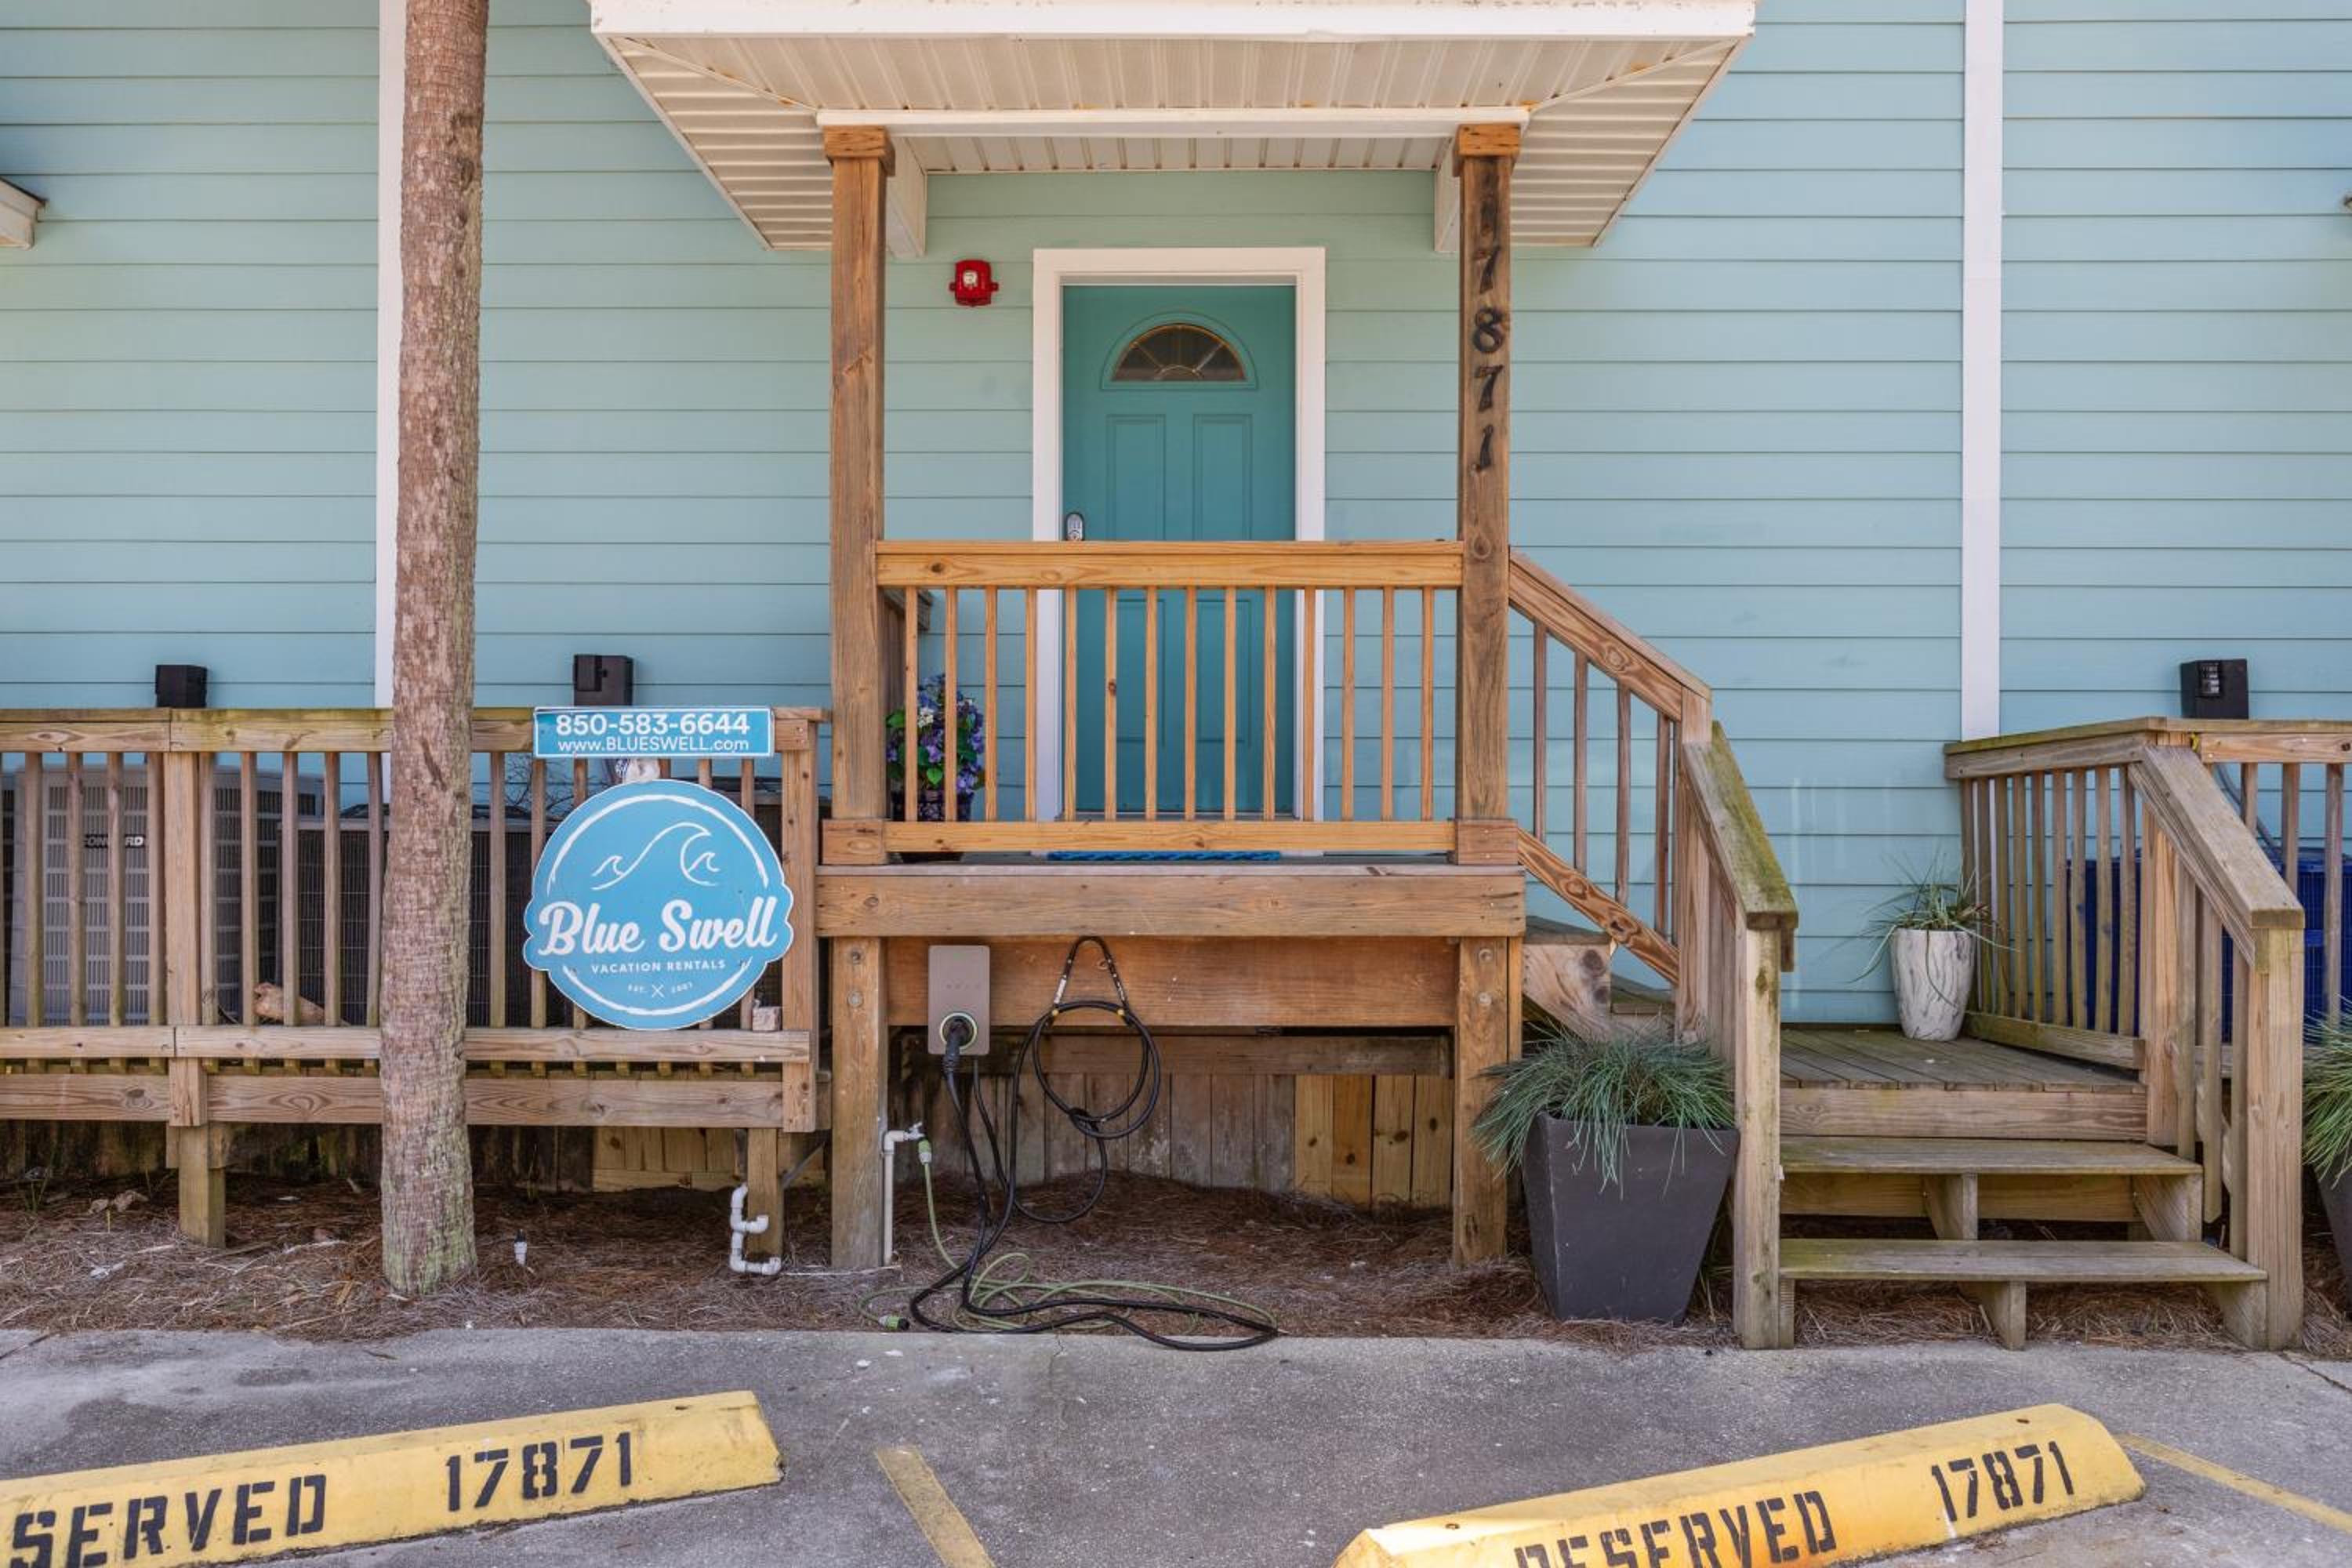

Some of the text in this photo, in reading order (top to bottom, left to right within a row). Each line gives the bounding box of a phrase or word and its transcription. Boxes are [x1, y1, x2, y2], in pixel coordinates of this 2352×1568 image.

[555, 713, 750, 736] 850-583-6644
[557, 735, 750, 753] www.BLUESWELL.com
[537, 895, 779, 956] Blue Swell
[591, 959, 727, 975] VACATION RENTALS
[9, 1432, 632, 1568] SERVED 17871
[1931, 1440, 2074, 1522] 17871
